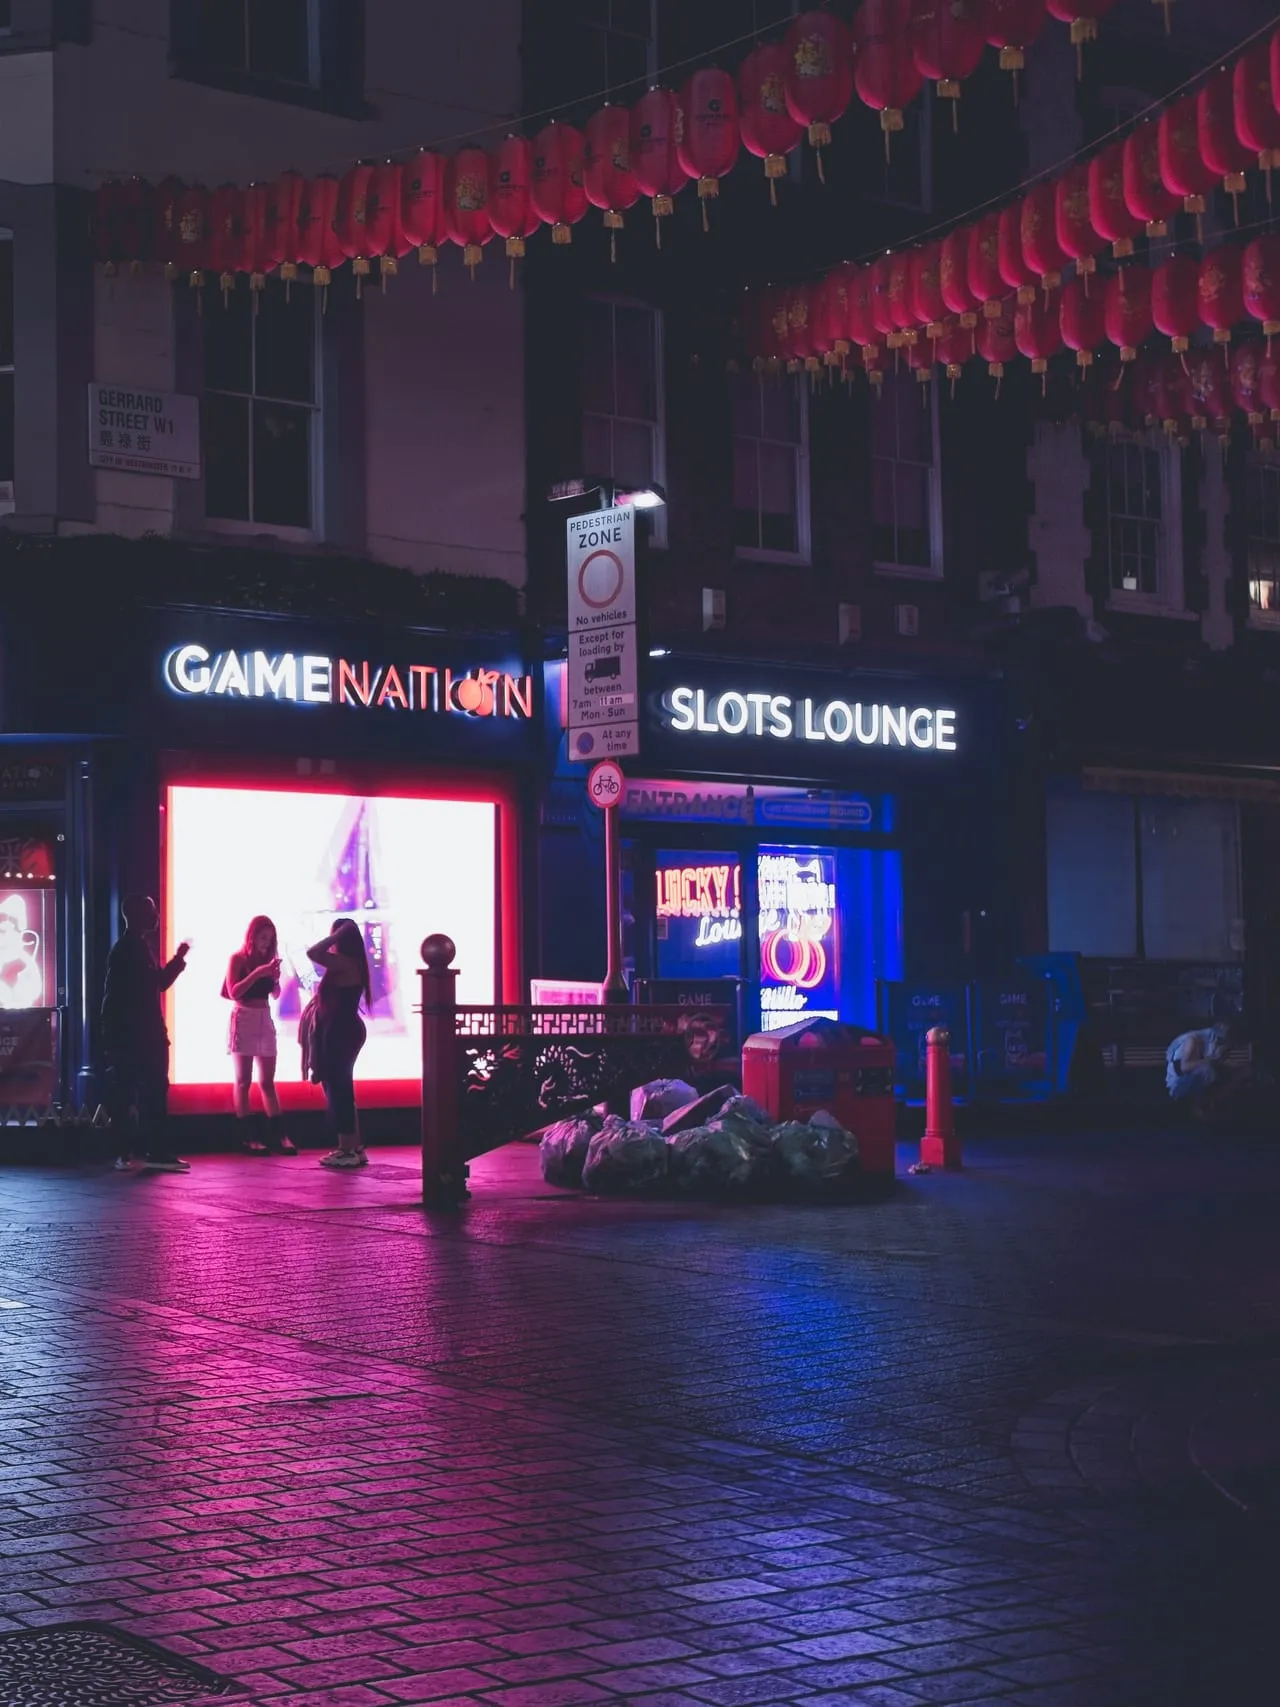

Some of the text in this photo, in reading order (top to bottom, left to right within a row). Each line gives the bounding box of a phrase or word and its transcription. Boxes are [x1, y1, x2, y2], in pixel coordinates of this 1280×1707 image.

[99, 389, 163, 413] GERRARD
[99, 409, 173, 434] STREET W1
[570, 511, 630, 532] PEDESTRIAN
[579, 527, 622, 548] ZONE
[576, 610, 627, 625] No vehicles
[579, 630, 624, 644] Except for
[579, 643, 625, 657] loading by
[584, 684, 622, 696] between
[572, 700, 592, 709] 7am
[581, 711, 600, 720] Mon
[607, 707, 626, 717] Sun
[670, 687, 957, 751] SLOTS LOUNGE
[602, 729, 632, 739] At any
[607, 741, 627, 751] time
[626, 789, 755, 818] ENTRANCE
[678, 993, 713, 1006] GAME
[911, 994, 941, 1008] GAME
